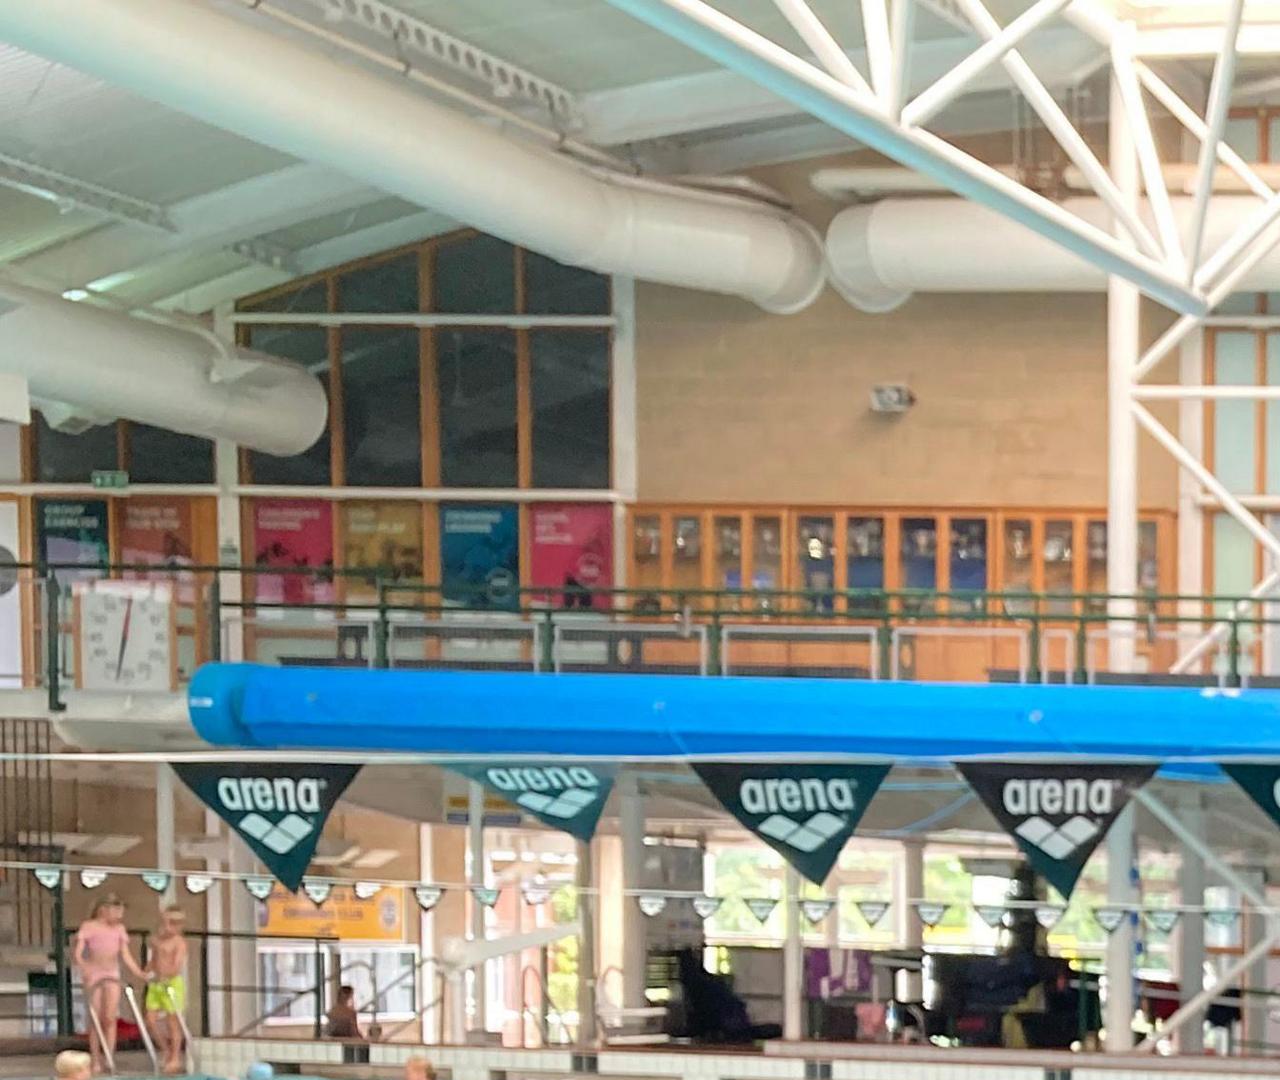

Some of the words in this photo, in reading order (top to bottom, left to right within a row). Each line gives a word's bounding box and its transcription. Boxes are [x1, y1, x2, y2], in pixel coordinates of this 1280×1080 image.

[218, 777, 320, 813] arena
[487, 766, 600, 792] arena
[741, 778, 855, 814] arena
[1003, 778, 1113, 815] arena
